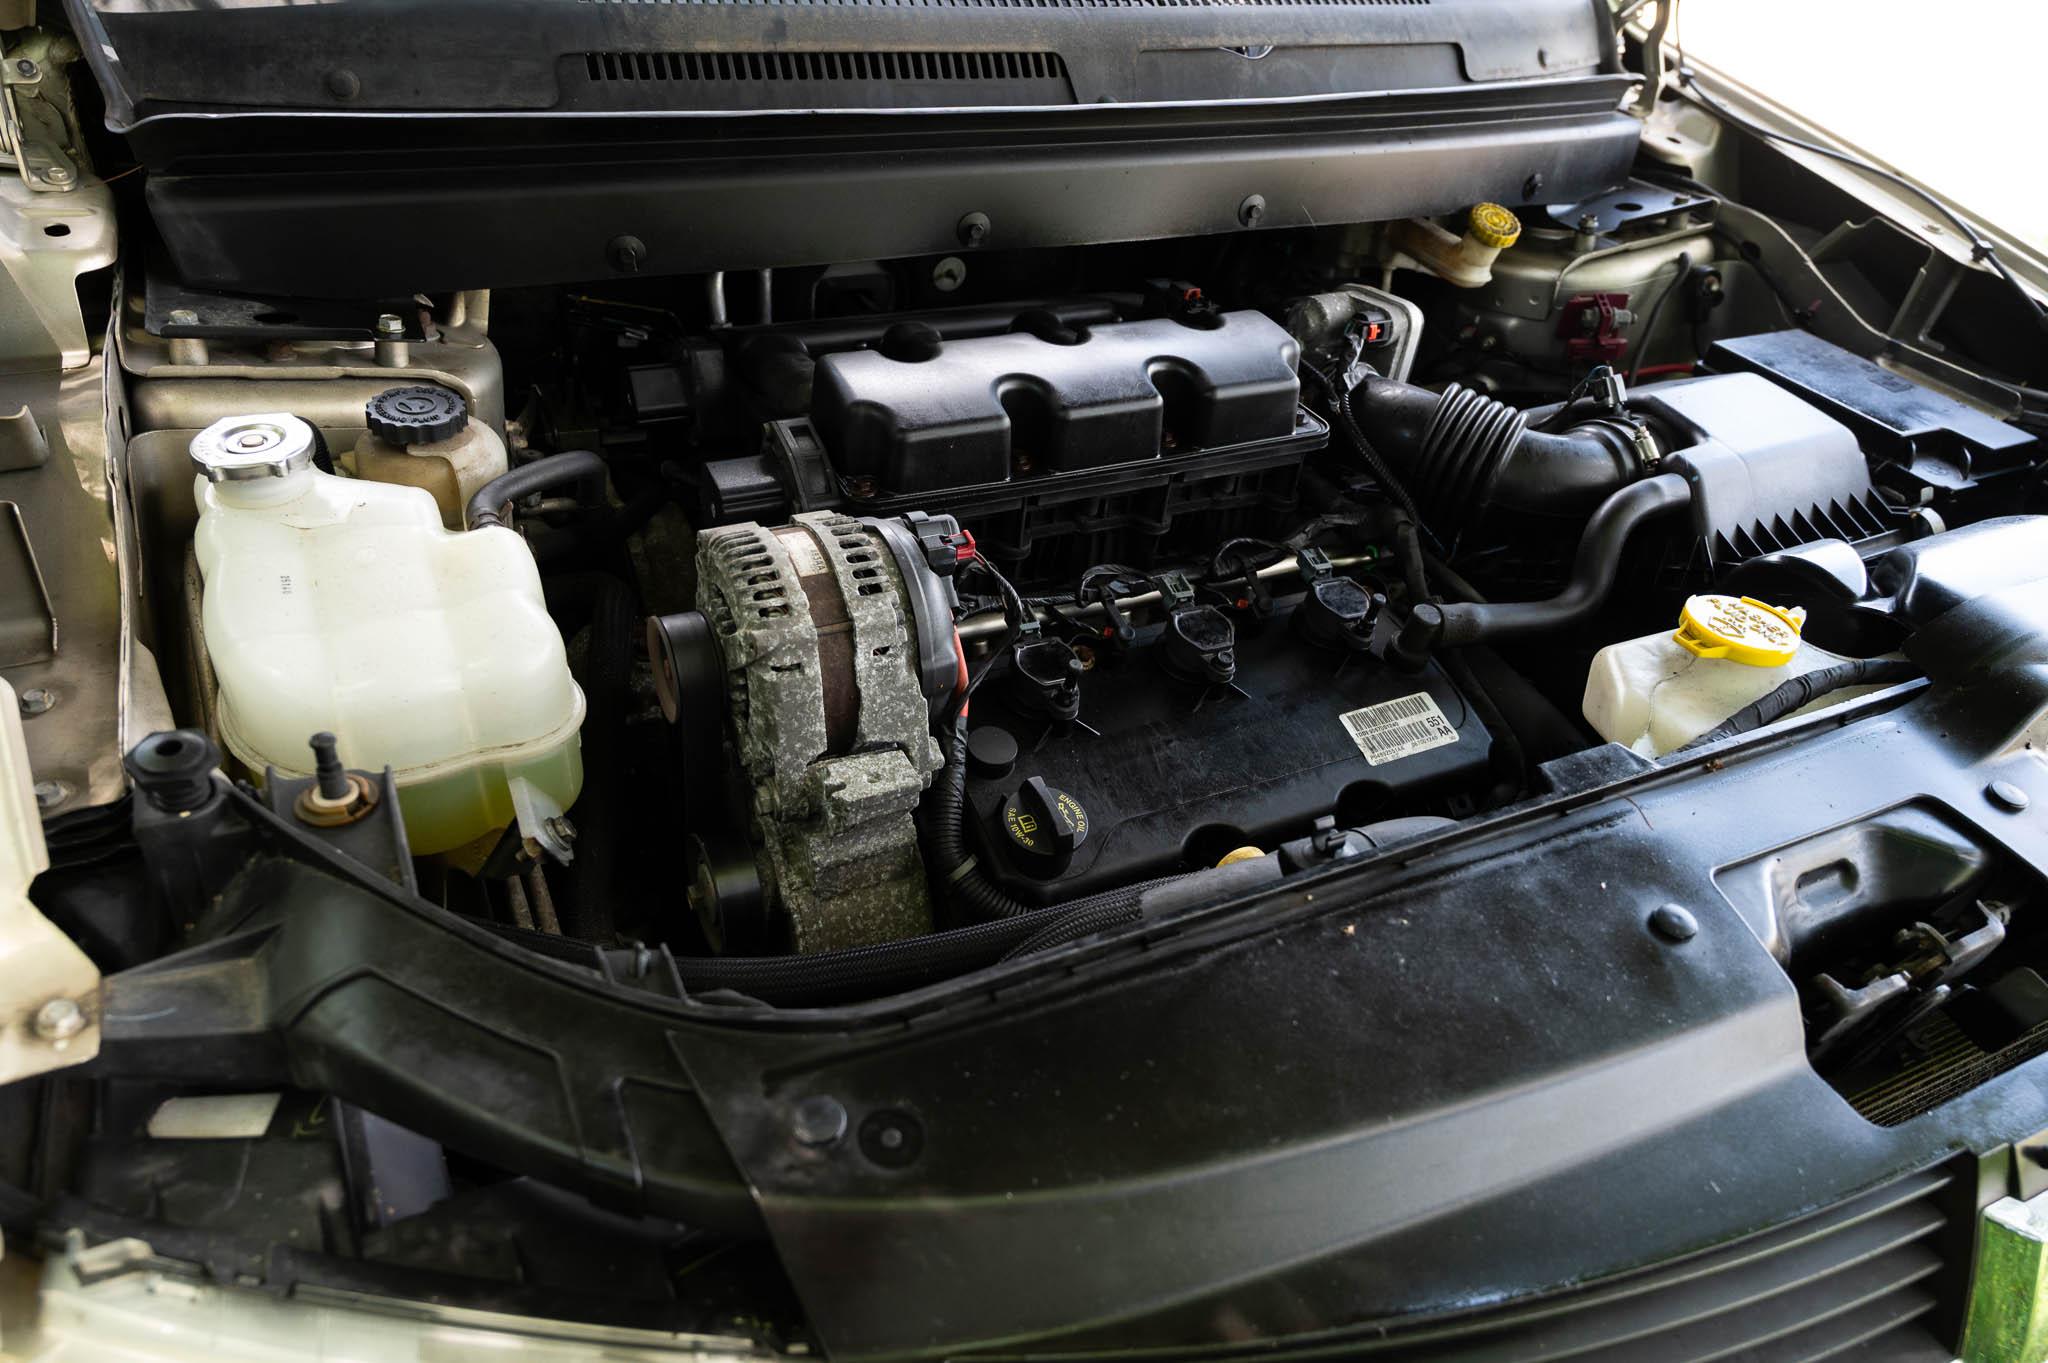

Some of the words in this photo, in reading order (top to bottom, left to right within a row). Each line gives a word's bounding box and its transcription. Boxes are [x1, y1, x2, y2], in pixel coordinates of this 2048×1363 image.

[1426, 715, 1446, 728] 551
[1437, 725, 1454, 738] AA
[1007, 806, 1017, 823] SAE
[1058, 793, 1085, 820] ENGINE
[1076, 820, 1087, 833] OIL
[1010, 823, 1035, 847] 10W-30
